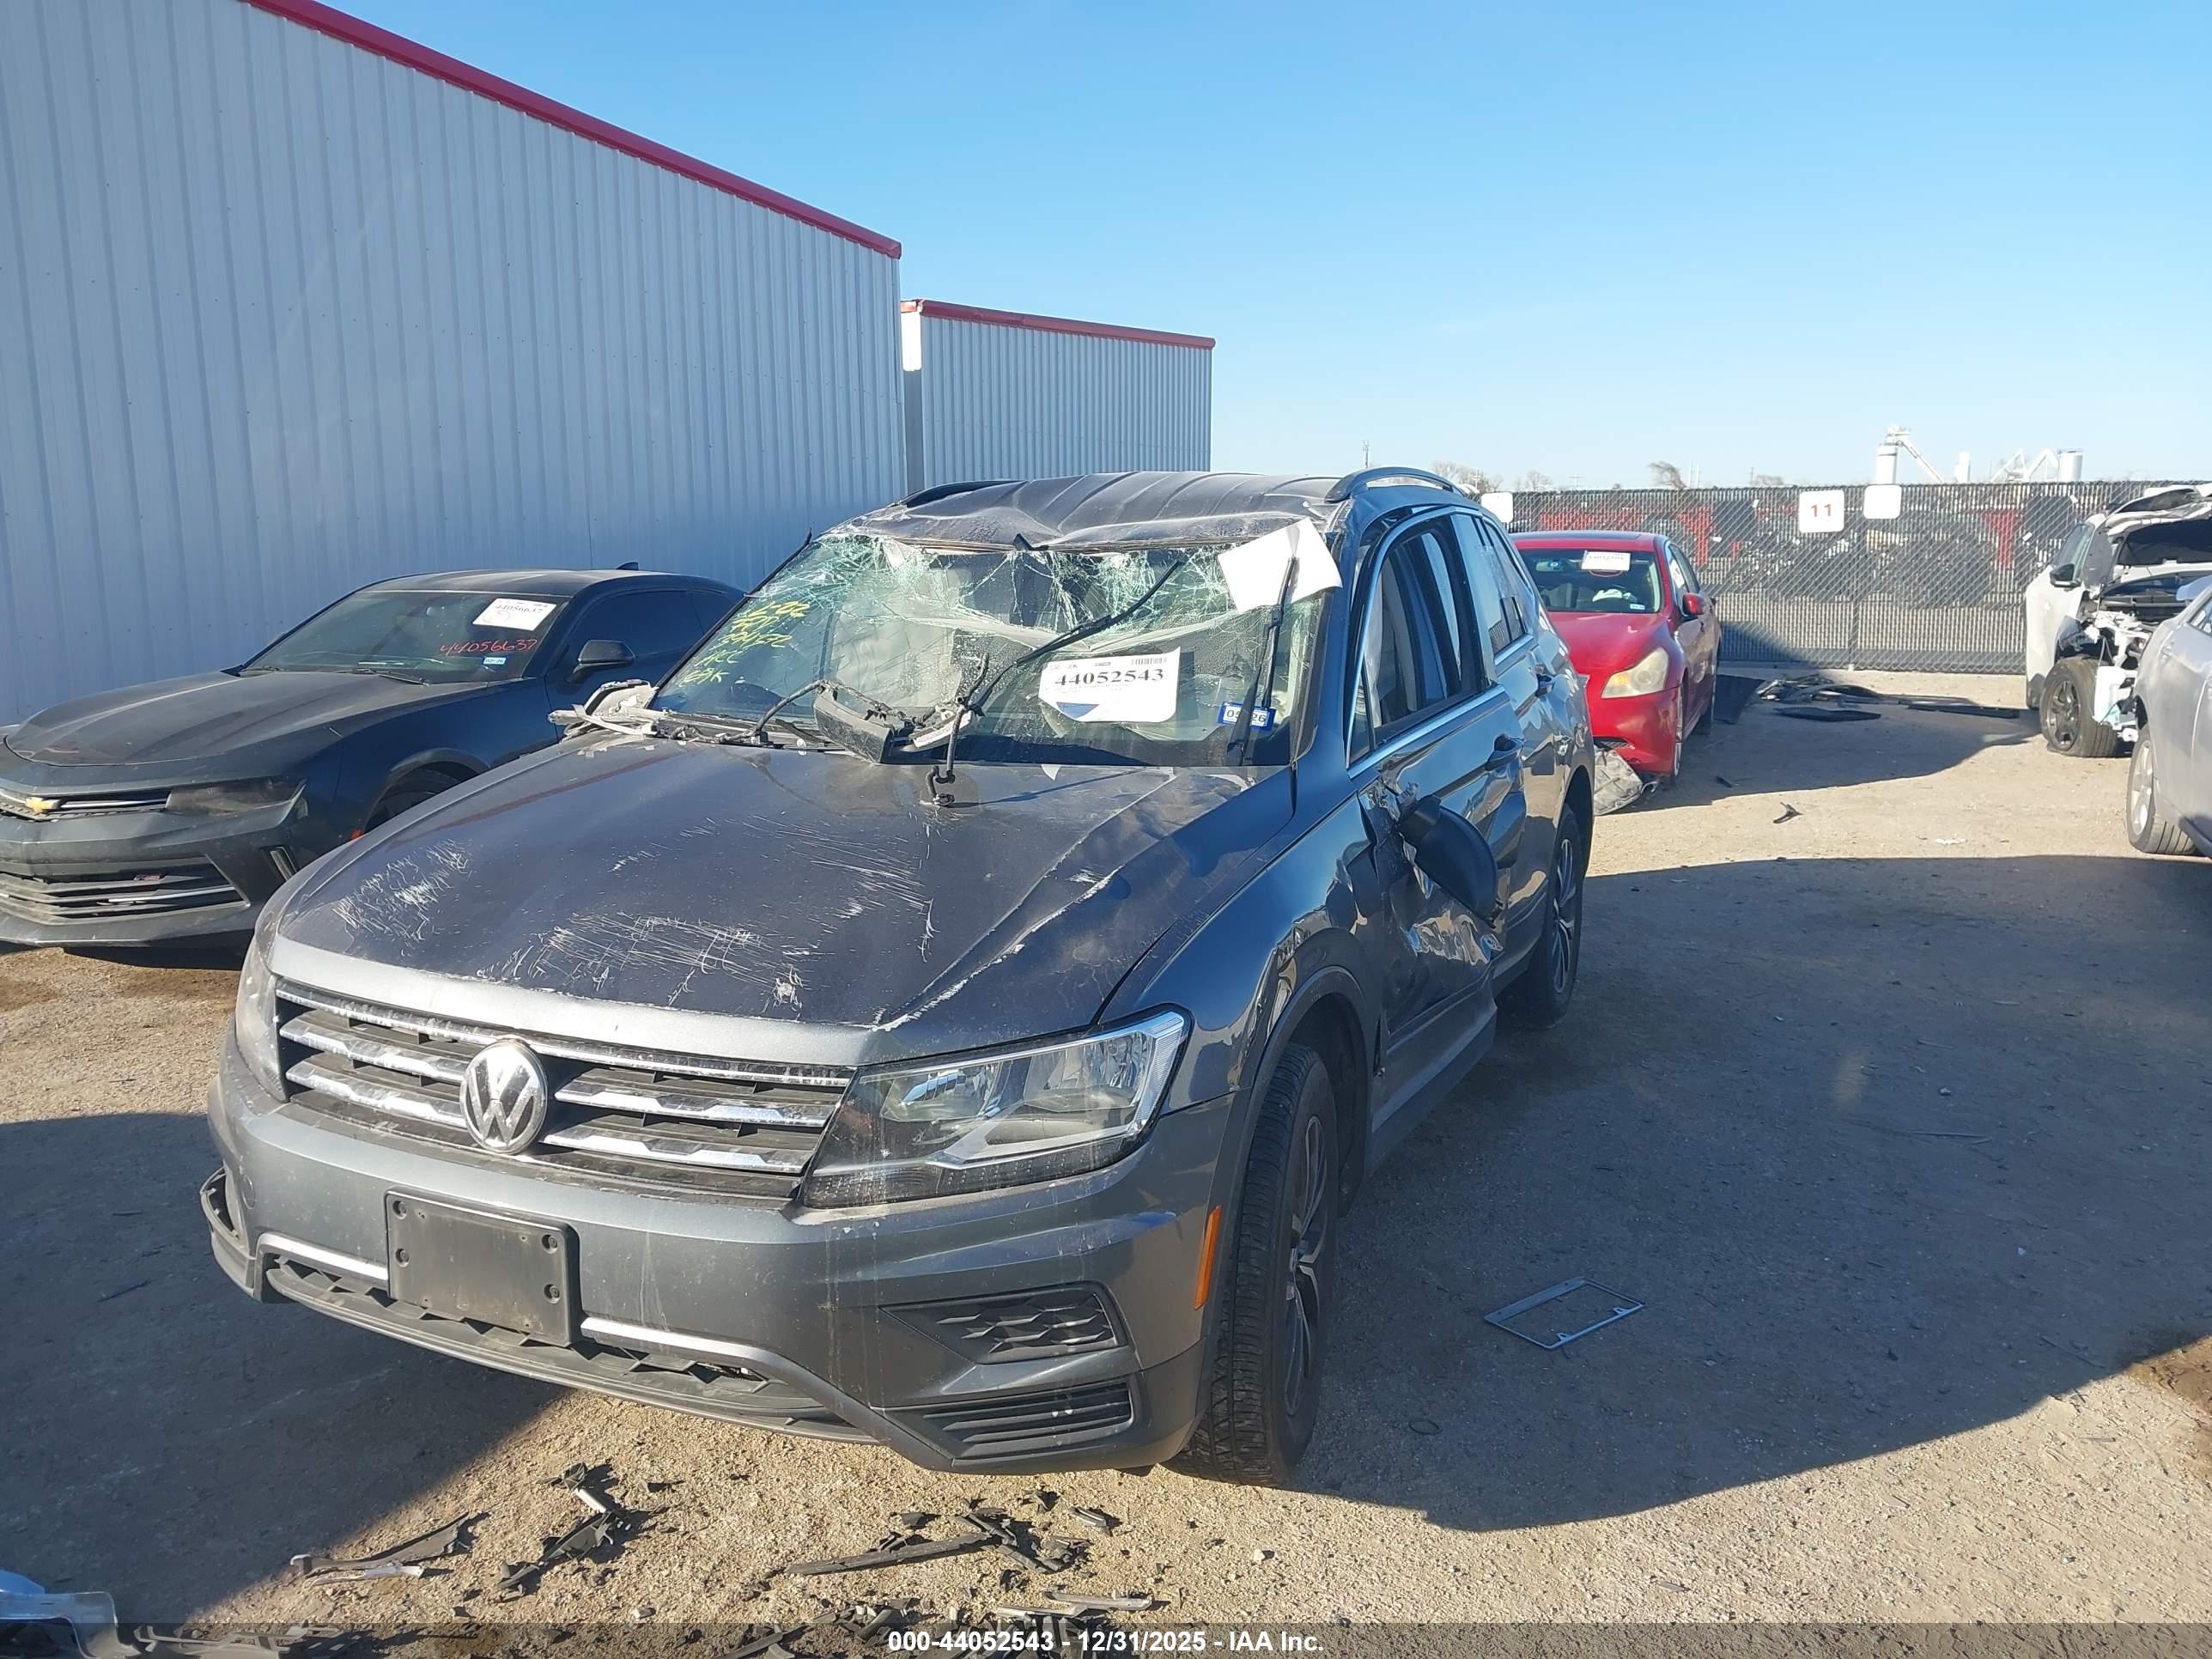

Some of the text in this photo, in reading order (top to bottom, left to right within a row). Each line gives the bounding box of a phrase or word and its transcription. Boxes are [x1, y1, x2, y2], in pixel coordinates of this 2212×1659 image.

[1810, 503, 1832, 518] 11
[440, 639, 537, 656] 44056637
[1054, 667, 1164, 686] 44052543
